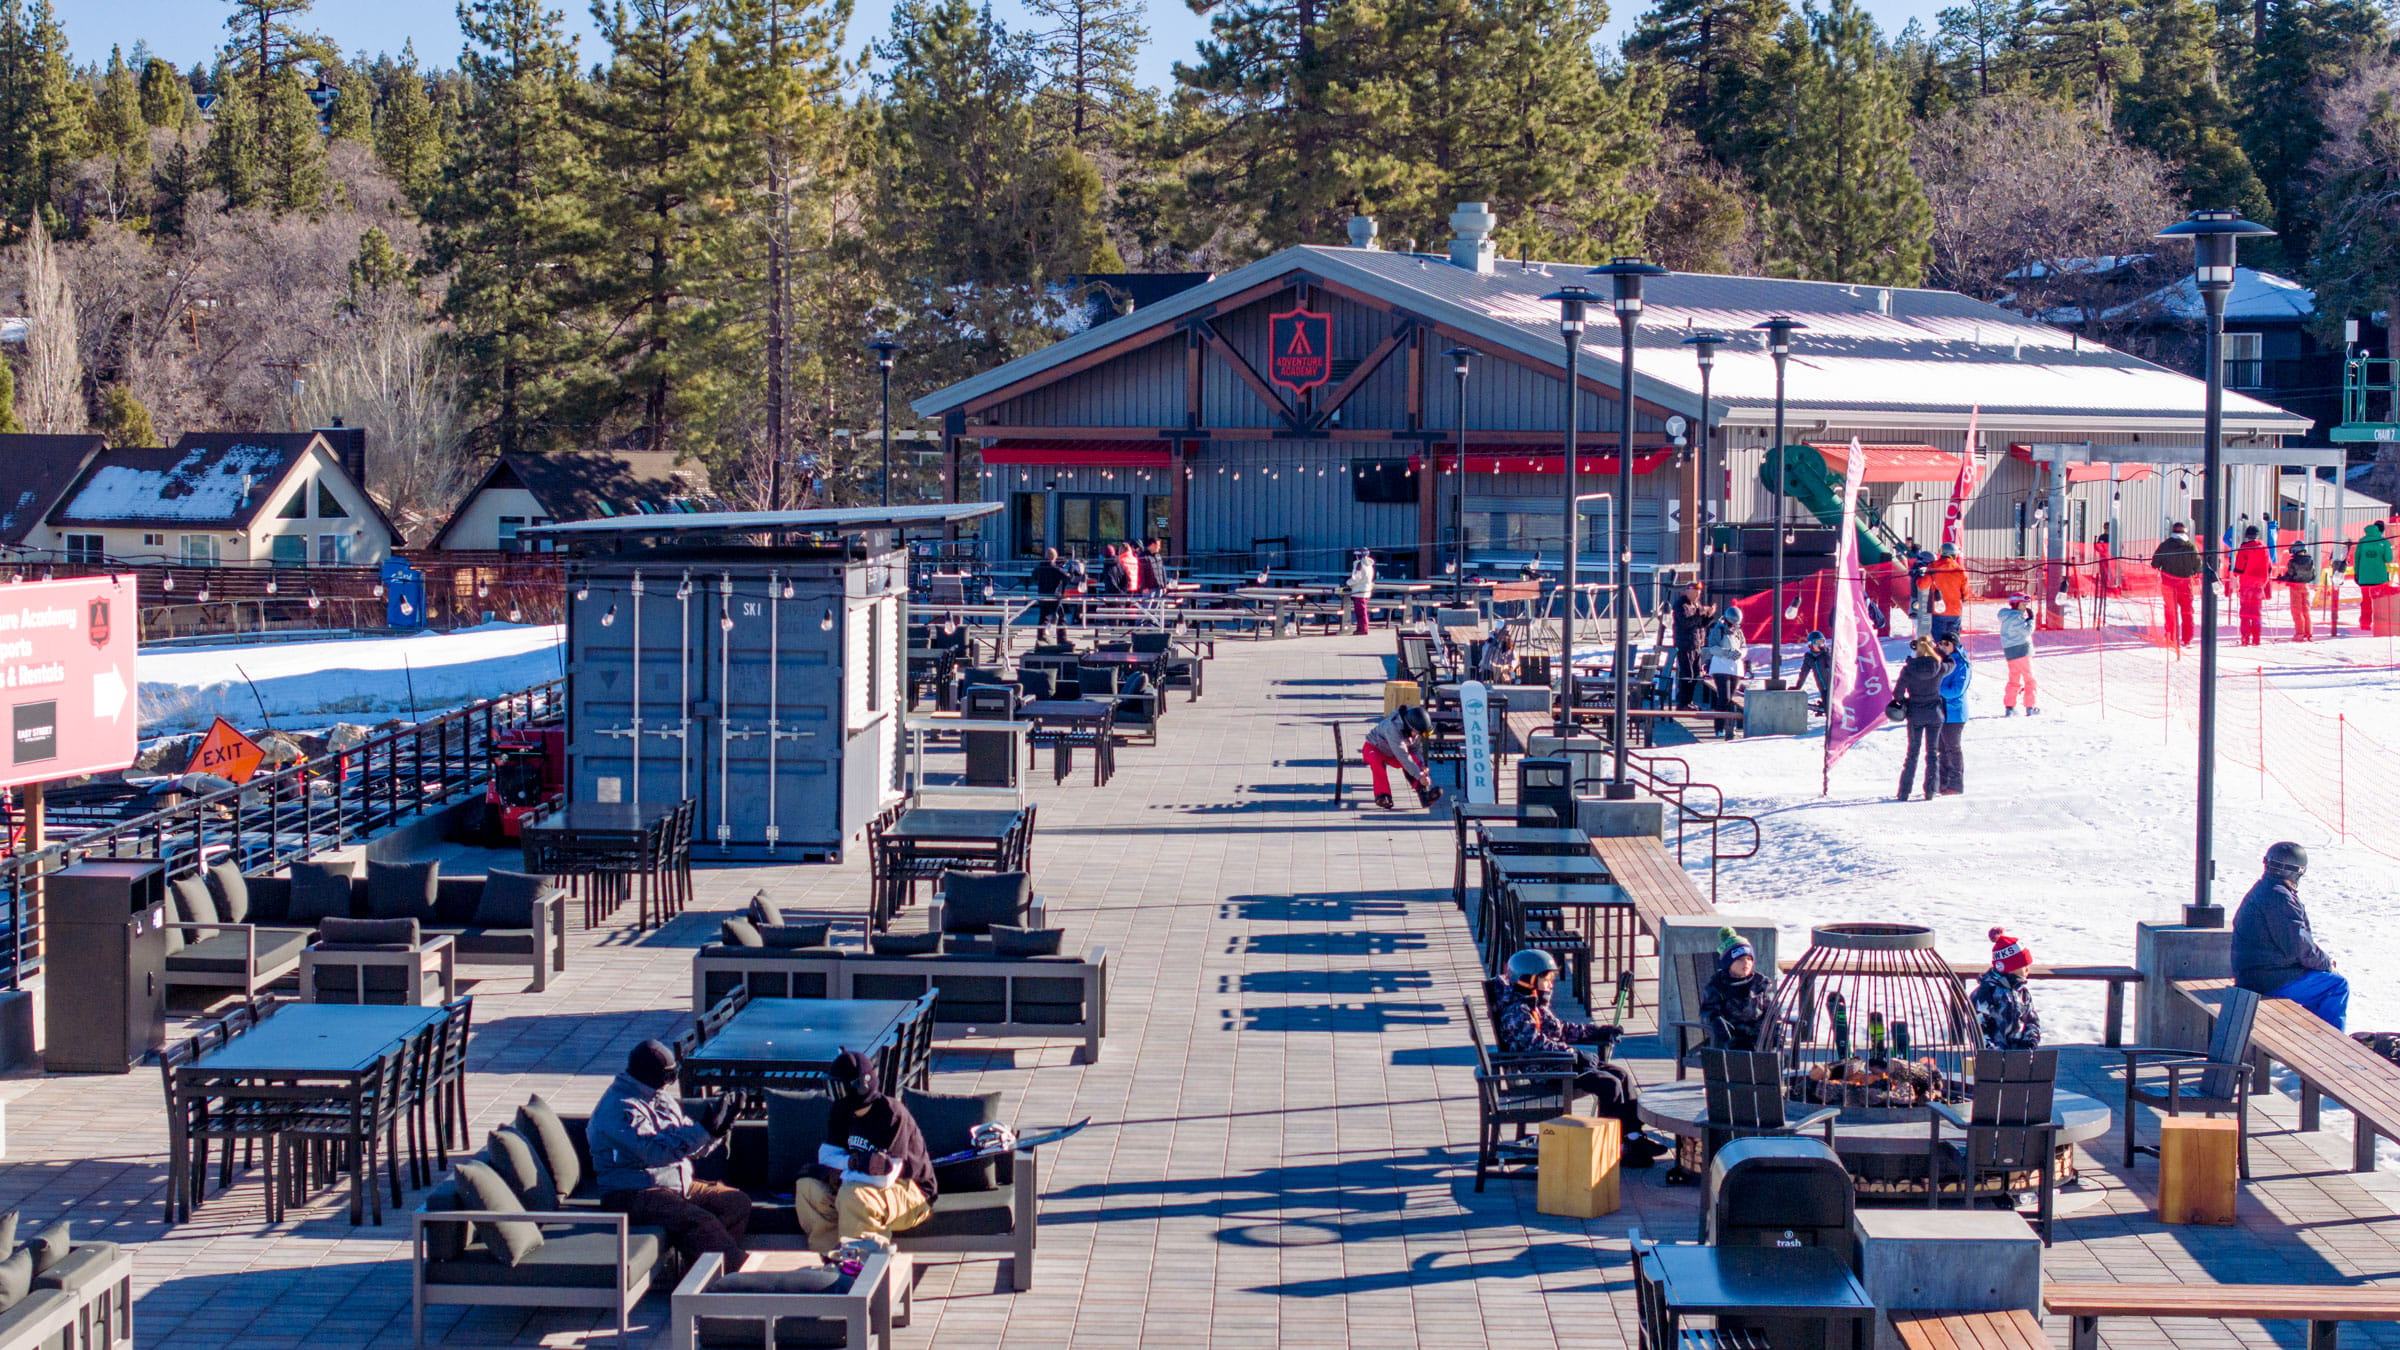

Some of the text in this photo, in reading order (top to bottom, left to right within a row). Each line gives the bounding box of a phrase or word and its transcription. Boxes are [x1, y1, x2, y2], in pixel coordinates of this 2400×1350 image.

[2374, 429, 2396, 441] CHAIR 7
[20, 606, 76, 629] Academy
[743, 602, 761, 616] SKI
[7, 666, 17, 687] &
[19, 661, 64, 686] Rentals
[203, 742, 243, 767] EXIT
[1471, 720, 1486, 787] ARBOR
[1776, 1238, 1801, 1248] trash
